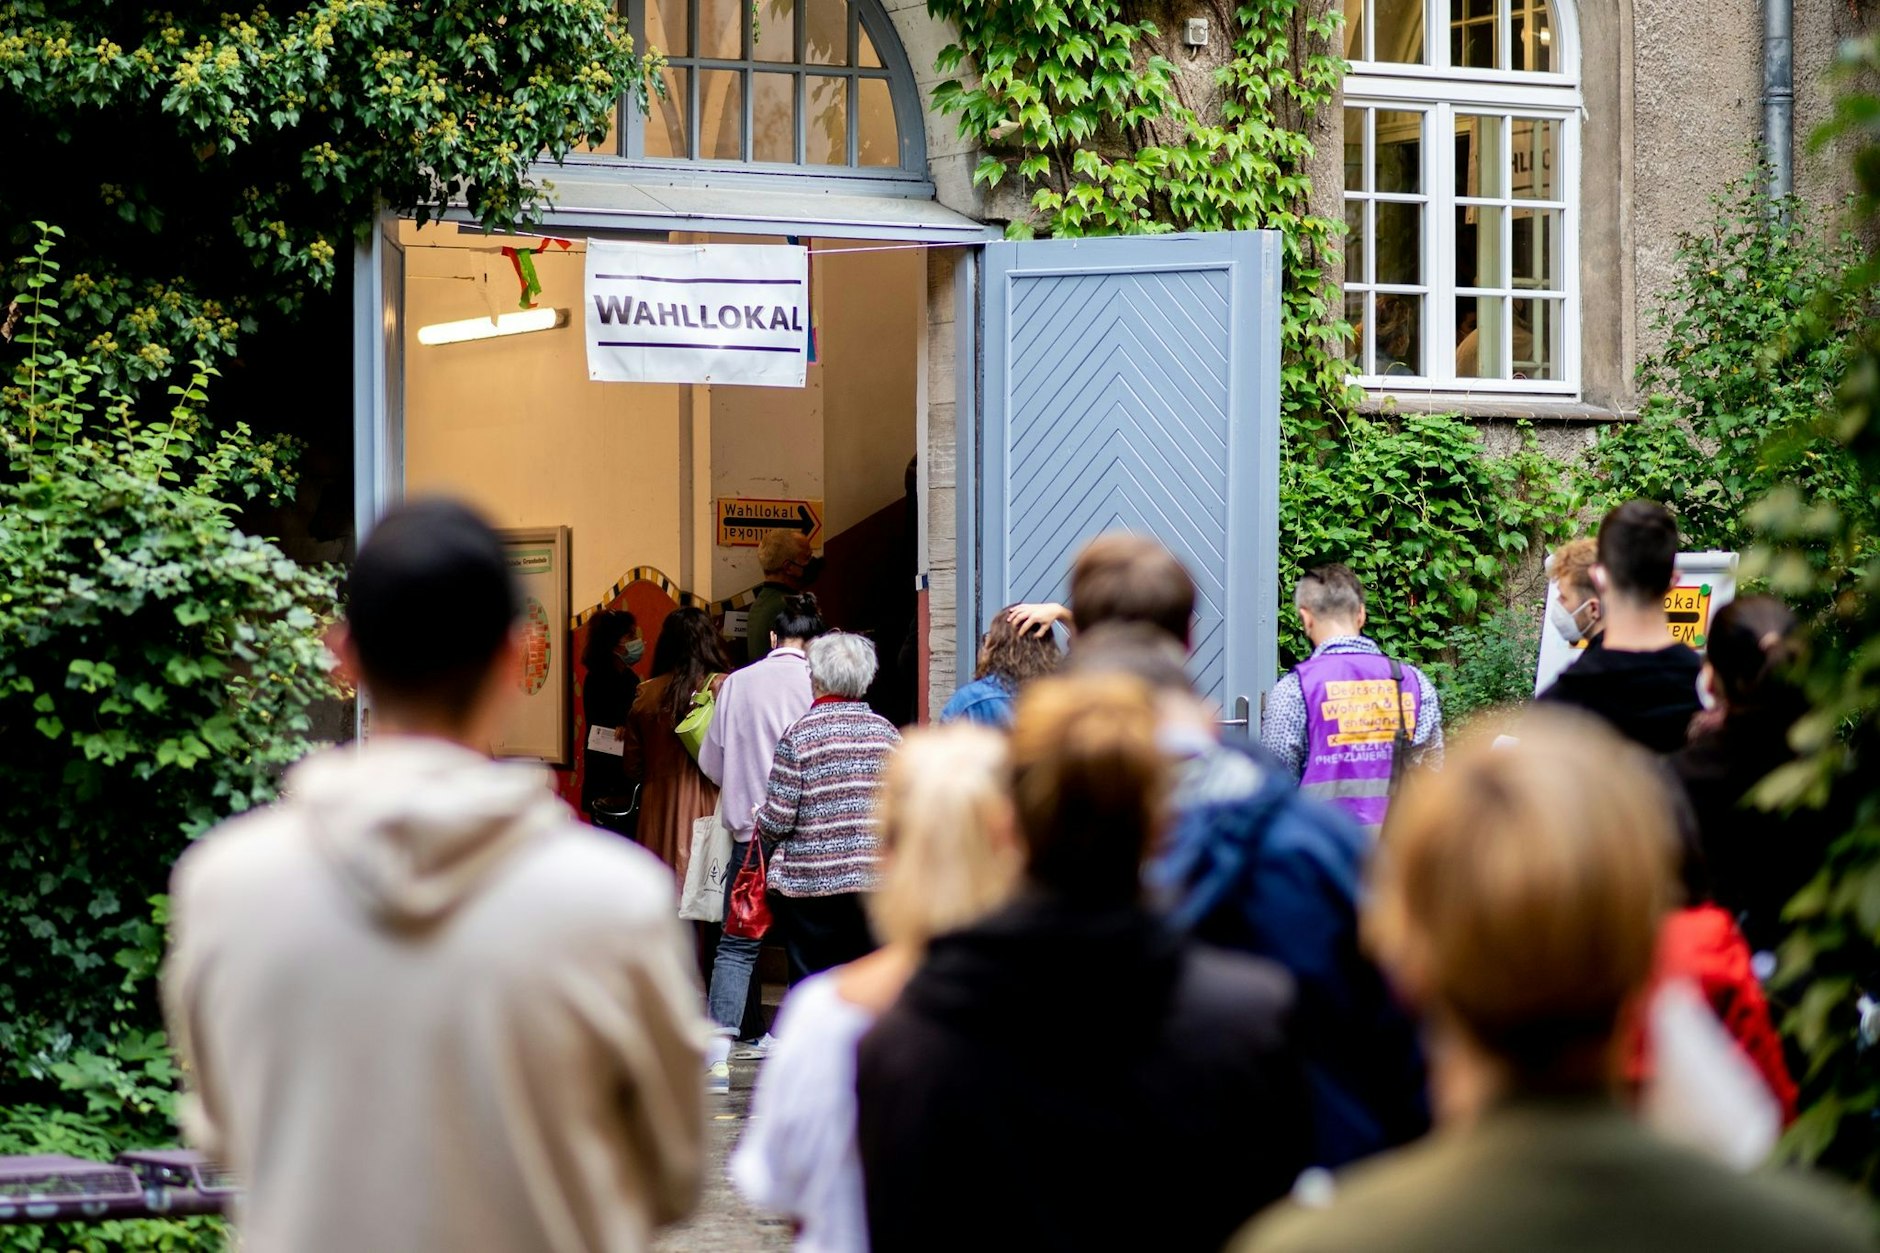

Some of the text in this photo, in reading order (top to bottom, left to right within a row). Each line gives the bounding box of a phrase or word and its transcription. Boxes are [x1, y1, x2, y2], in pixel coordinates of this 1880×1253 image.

[593, 294, 803, 332] WAHLLOKAL
[724, 503, 794, 519] Wahllokal
[724, 527, 772, 541] llokal
[1663, 592, 1701, 609] okal
[1330, 683, 1394, 697] Deutsche
[1325, 701, 1379, 716] Wohnen
